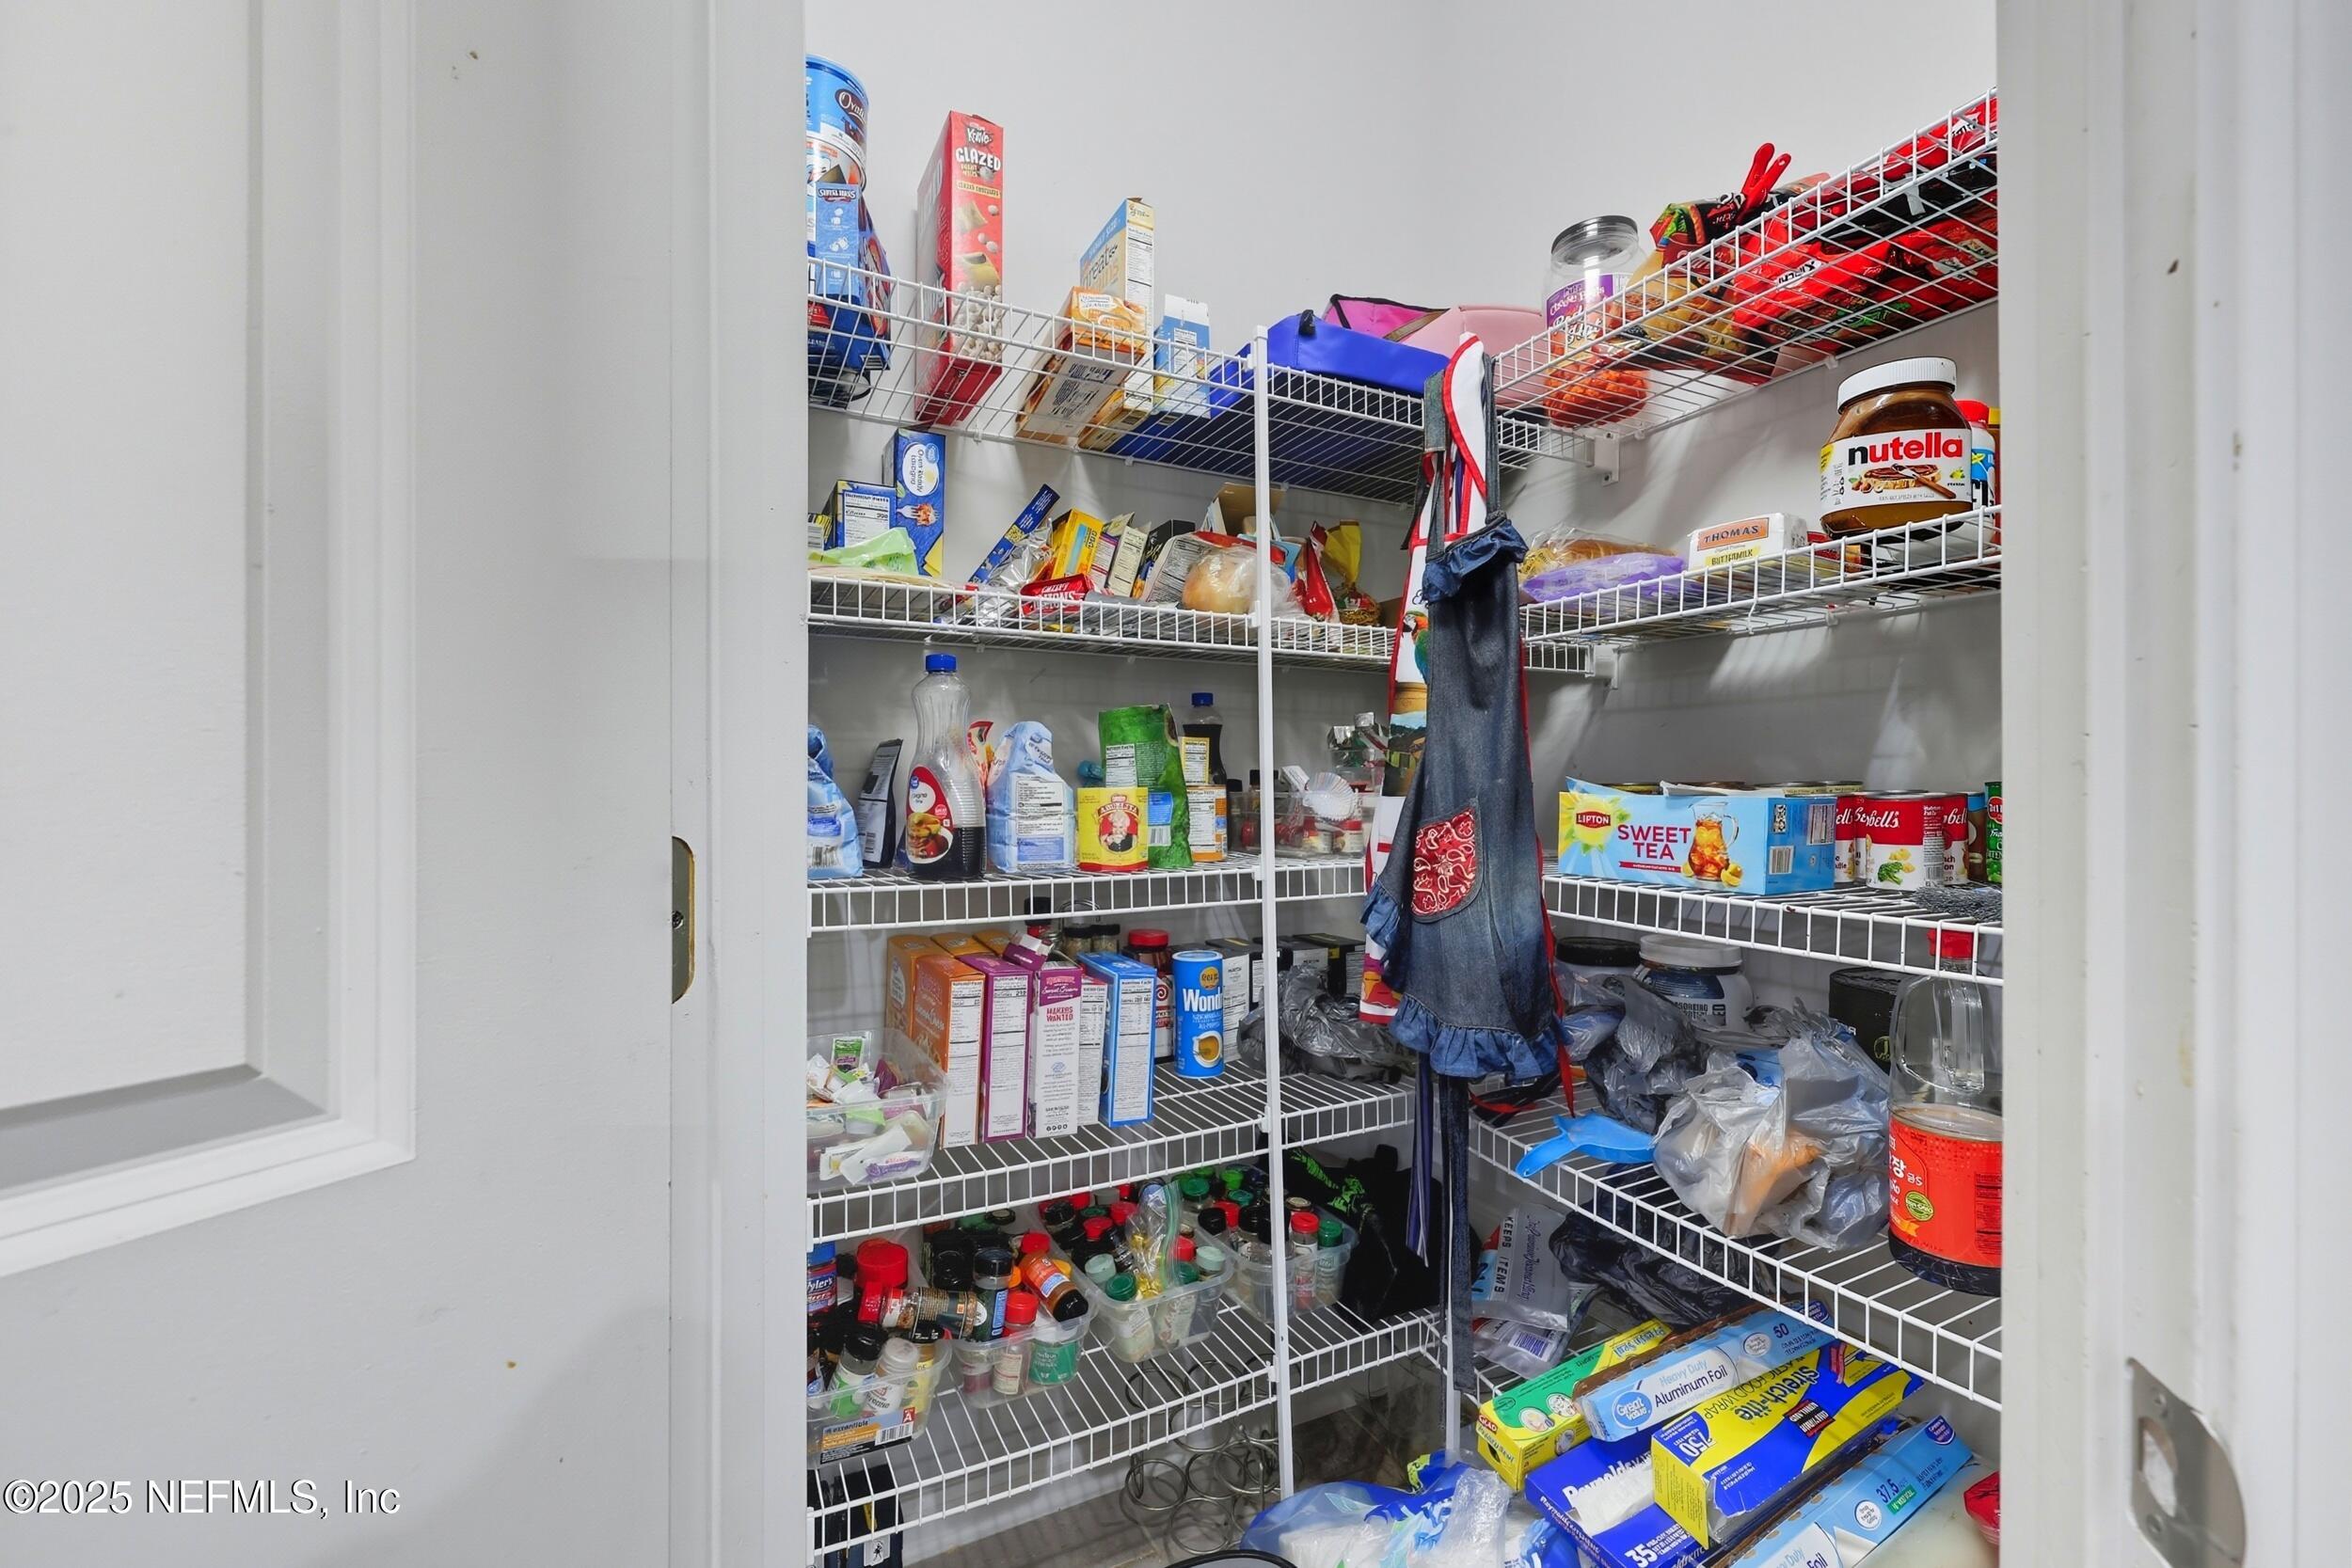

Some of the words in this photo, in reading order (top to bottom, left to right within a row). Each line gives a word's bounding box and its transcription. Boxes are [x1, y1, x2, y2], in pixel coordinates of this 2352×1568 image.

[955, 146, 1002, 171] GLAZED
[1848, 432, 1963, 467] nutella
[1704, 525, 1759, 544] THOMAS
[1578, 814, 1610, 825] LIPTON
[1617, 824, 1692, 844] SWEET
[1632, 842, 1676, 861] TEA
[1182, 986, 1223, 1012] Wond
[1502, 1215, 1515, 1249] KEEPS
[1494, 1255, 1510, 1294] ITEMS
[1659, 1366, 1688, 1387] Heavy
[1687, 1358, 1708, 1376] Duty
[1653, 1377, 1708, 1409] Aluminum
[1706, 1364, 1729, 1386] Foil
[1615, 1397, 1645, 1418] Great
[1701, 1393, 1734, 1420] WRAP
[1478, 1414, 1498, 1433] GLAD
[1680, 1432, 1717, 1458] 750
[1875, 1478, 1900, 1504] 37.5
[1624, 1543, 1660, 1568] 35
